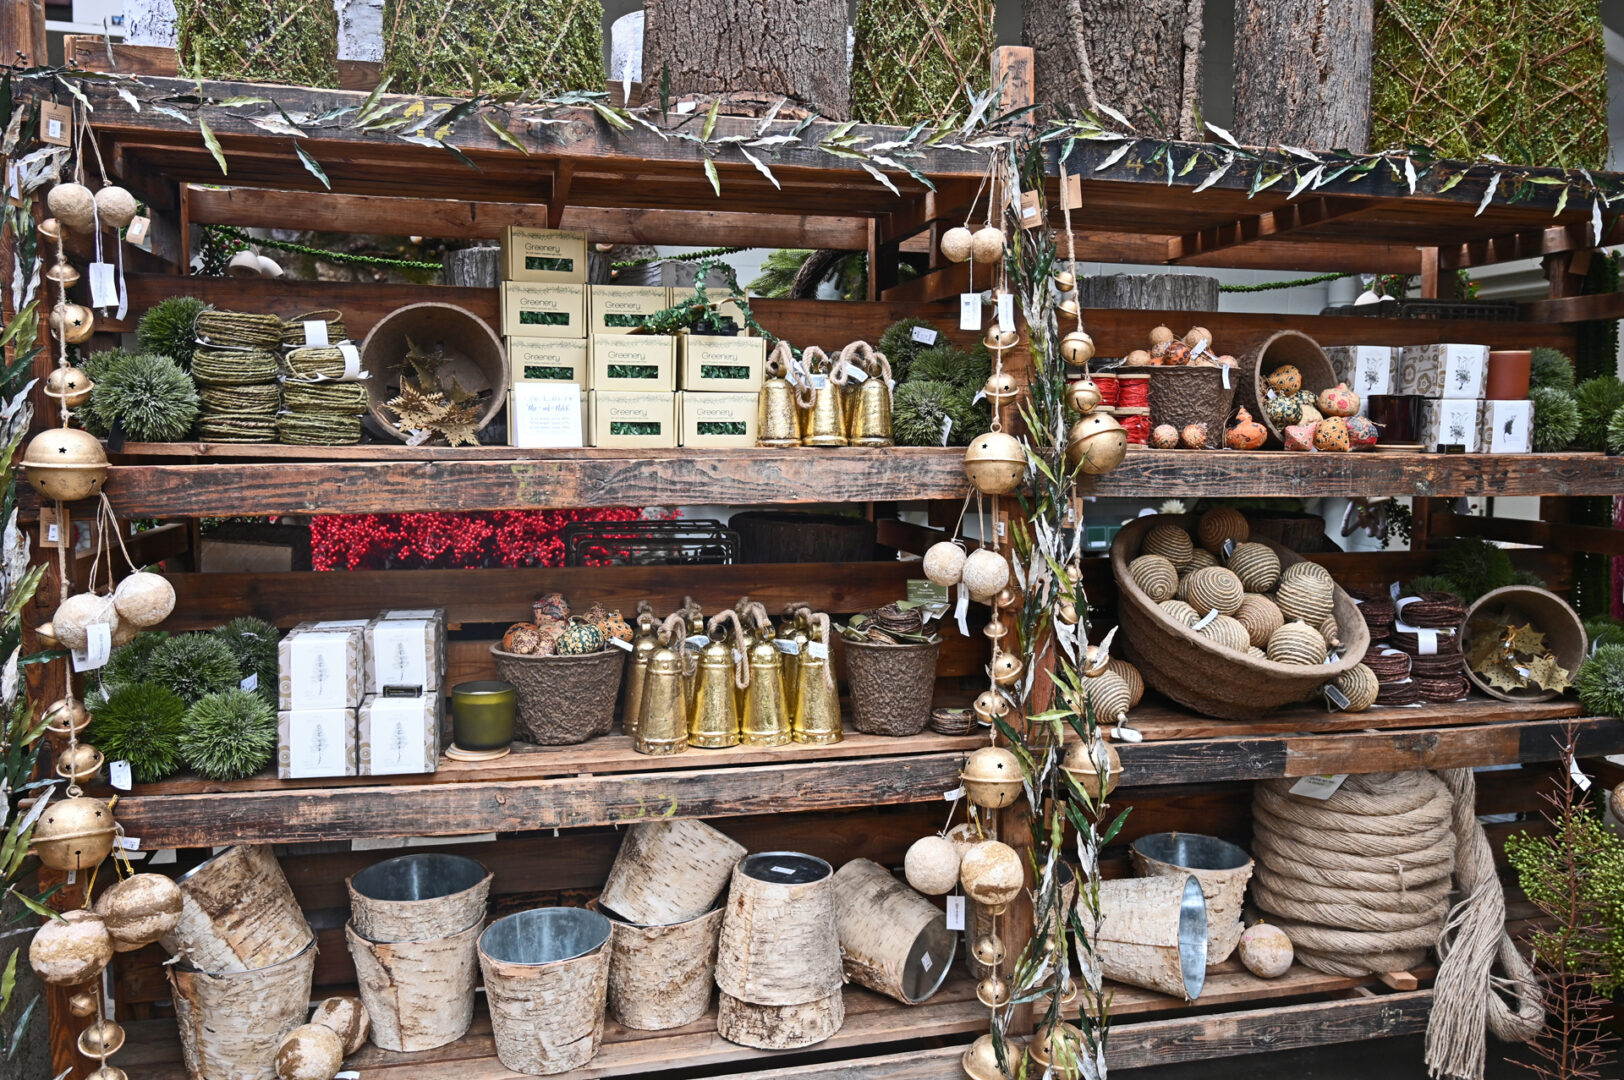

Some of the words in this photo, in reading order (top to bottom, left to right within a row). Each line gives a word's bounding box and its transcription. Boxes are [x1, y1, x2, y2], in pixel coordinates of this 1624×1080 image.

[525, 243, 561, 253] Greenery
[520, 298, 557, 308] Greenery
[605, 301, 641, 309] Greenery
[524, 353, 560, 362] Greenery
[608, 351, 646, 360] Greenery
[702, 352, 738, 361] Greenery
[610, 408, 648, 417] Greenery
[697, 408, 733, 417] Greenery
